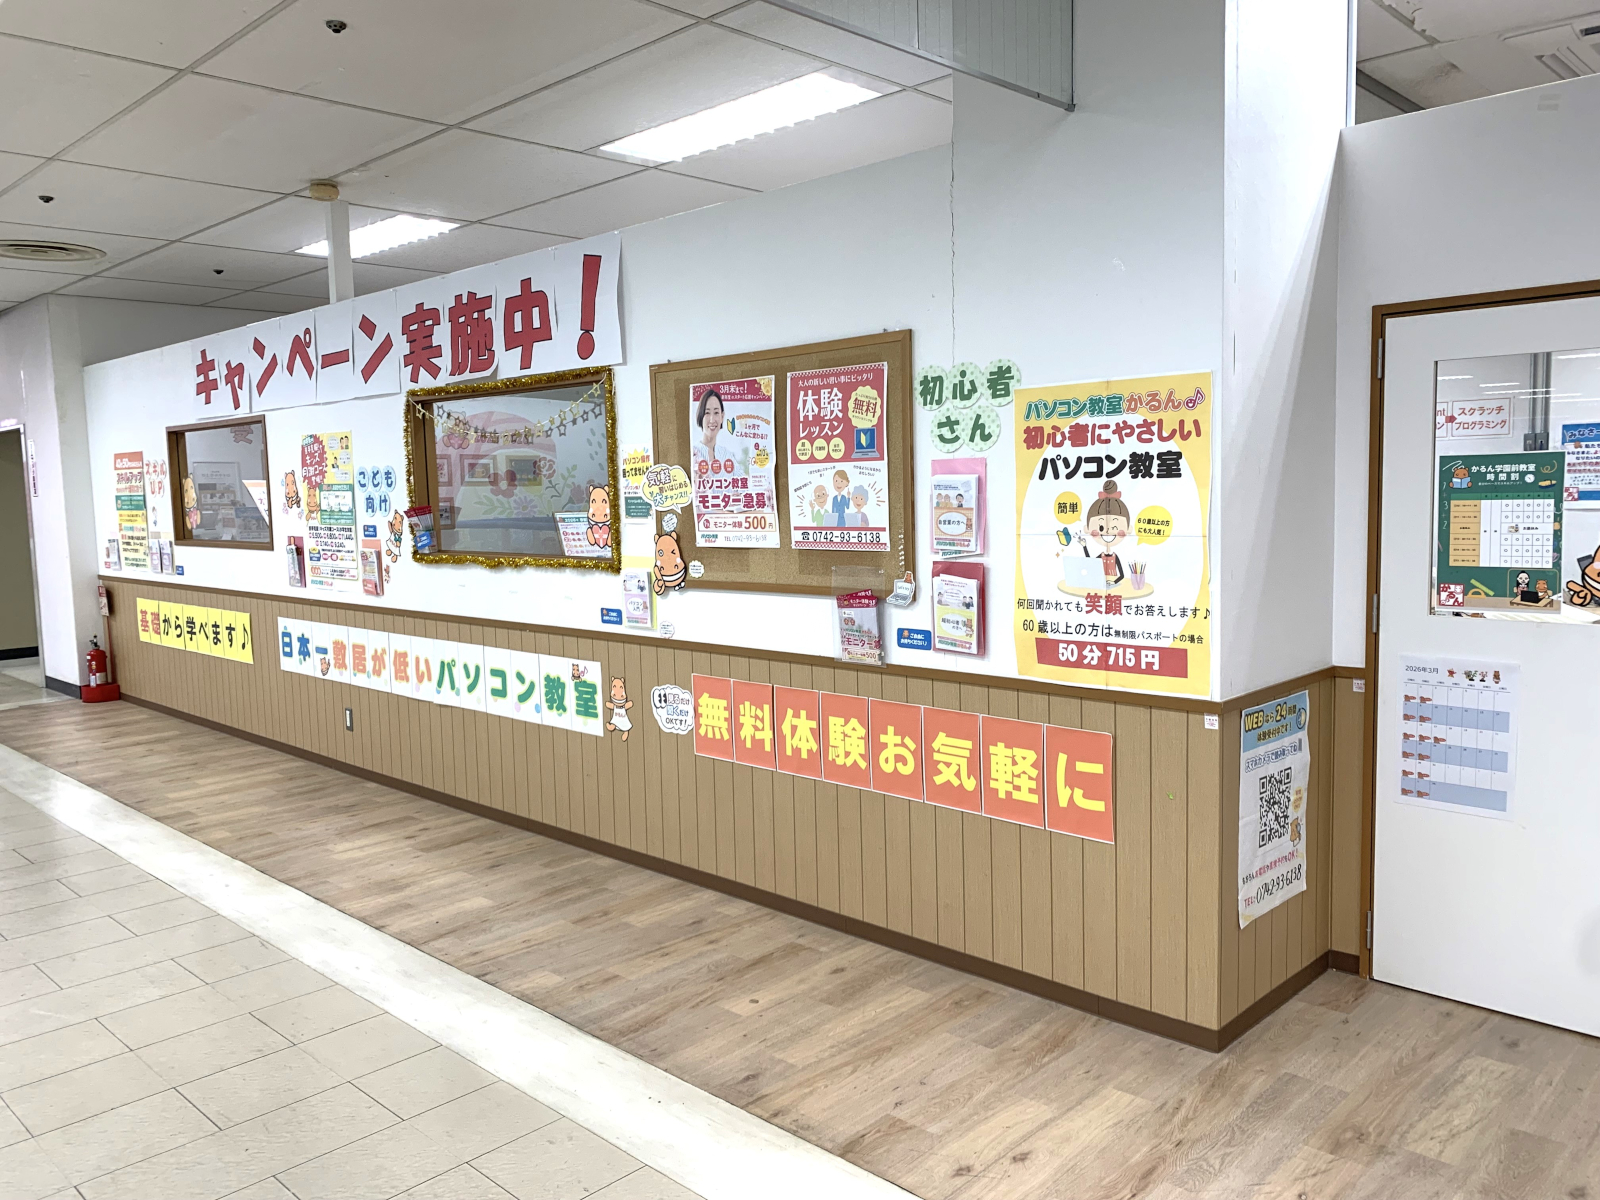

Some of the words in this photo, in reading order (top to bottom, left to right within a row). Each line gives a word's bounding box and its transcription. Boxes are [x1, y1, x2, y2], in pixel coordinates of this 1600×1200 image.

[195, 254, 602, 411] キャンペーン実施中！
[798, 372, 873, 388] 大人の新しい習い事にピッタリ
[919, 365, 1015, 407] 初心者
[796, 387, 843, 422] 体験
[851, 397, 878, 419] 無料
[1457, 405, 1505, 417] スクラッチ
[799, 420, 844, 438] レッスン
[936, 413, 993, 445] さん
[1023, 418, 1202, 450] 初心者にやさしい
[1454, 419, 1508, 431] プログラミング
[145, 462, 167, 476] スキル
[1038, 450, 1183, 481] パソコン教室
[1471, 463, 1537, 473] かるん学園前教室
[358, 469, 394, 488] こども
[646, 468, 678, 488] 気軽に
[658, 480, 688, 494] 習いはじめる
[697, 477, 749, 490] パソコン教室
[149, 480, 163, 495] UP
[365, 494, 388, 514] 向け
[698, 492, 767, 510] モニター急募
[1057, 501, 1079, 515] 簡単
[713, 520, 743, 529] モニター体験
[744, 515, 767, 530] 500
[812, 531, 881, 543] 0742-93-6138
[1022, 619, 1035, 632] 60
[1058, 643, 1078, 662] 50
[1082, 644, 1102, 665] 分
[1106, 646, 1136, 668] 715
[1140, 650, 1160, 671] 円
[281, 627, 600, 720] 日本一敷居が低いパソコン教室
[1405, 665, 1439, 674] 2026年3月
[698, 692, 1106, 813] 無料体験お気軽に
